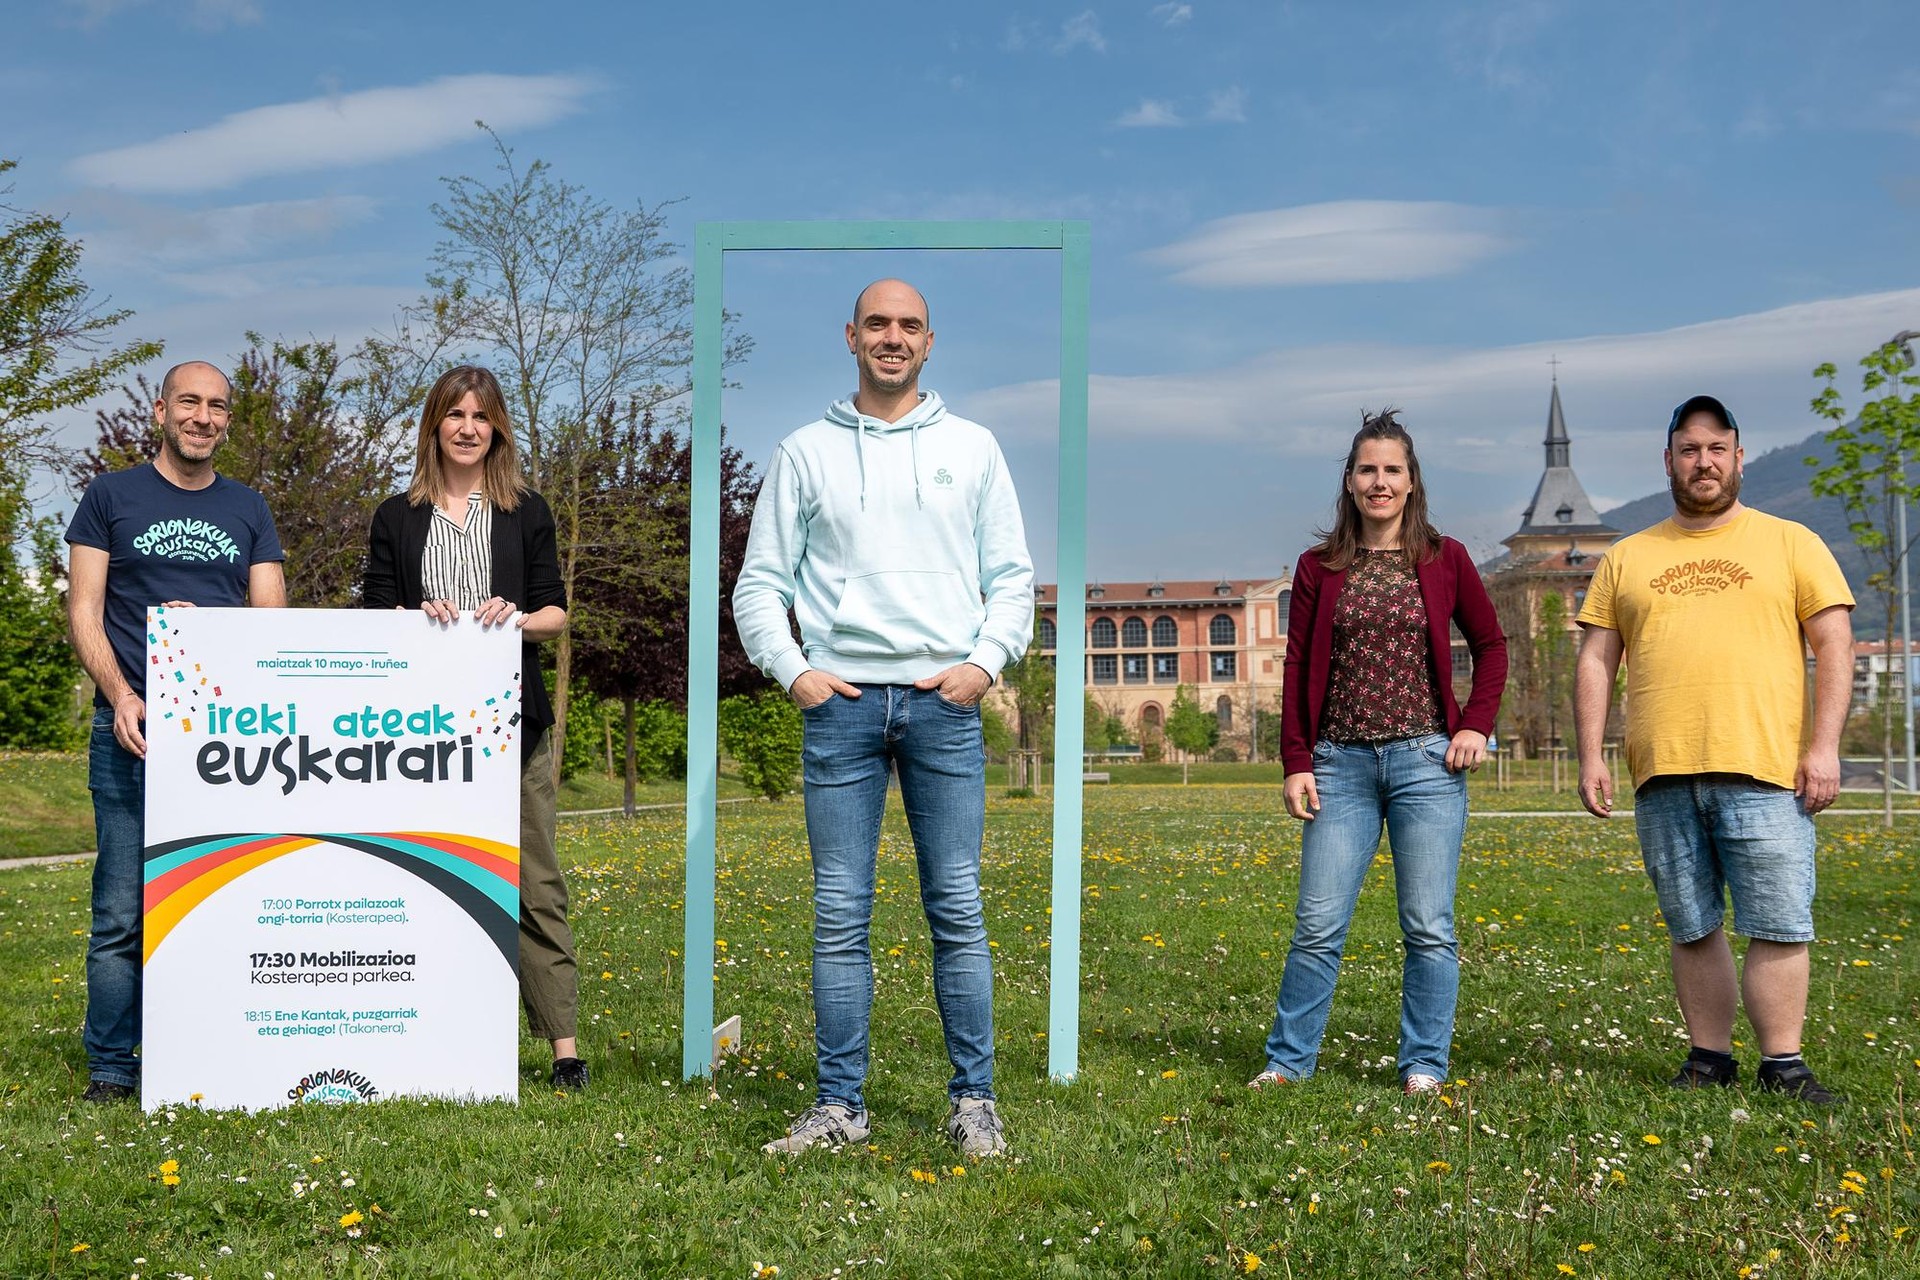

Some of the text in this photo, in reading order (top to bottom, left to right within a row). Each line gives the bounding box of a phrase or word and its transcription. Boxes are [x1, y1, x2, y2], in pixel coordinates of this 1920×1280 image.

[155, 535, 220, 560] euskara
[1670, 575, 1730, 595] euskara
[257, 658, 408, 671] maiatzak 10 mayo Iruñea
[207, 703, 455, 738] ireki ateak
[196, 735, 473, 796] euskarari
[262, 898, 405, 911] 17:00 Porrotx pailazoak
[258, 912, 409, 926] ongi-torria (Kosterapea).
[250, 950, 416, 968] 17:30 Mobilizazioa
[251, 968, 415, 986] Kosterapea parkea.
[244, 1008, 418, 1022] 18:15 Ene Kantak, puzgarriak
[258, 1021, 407, 1037] eta gehiago! (Takonera).
